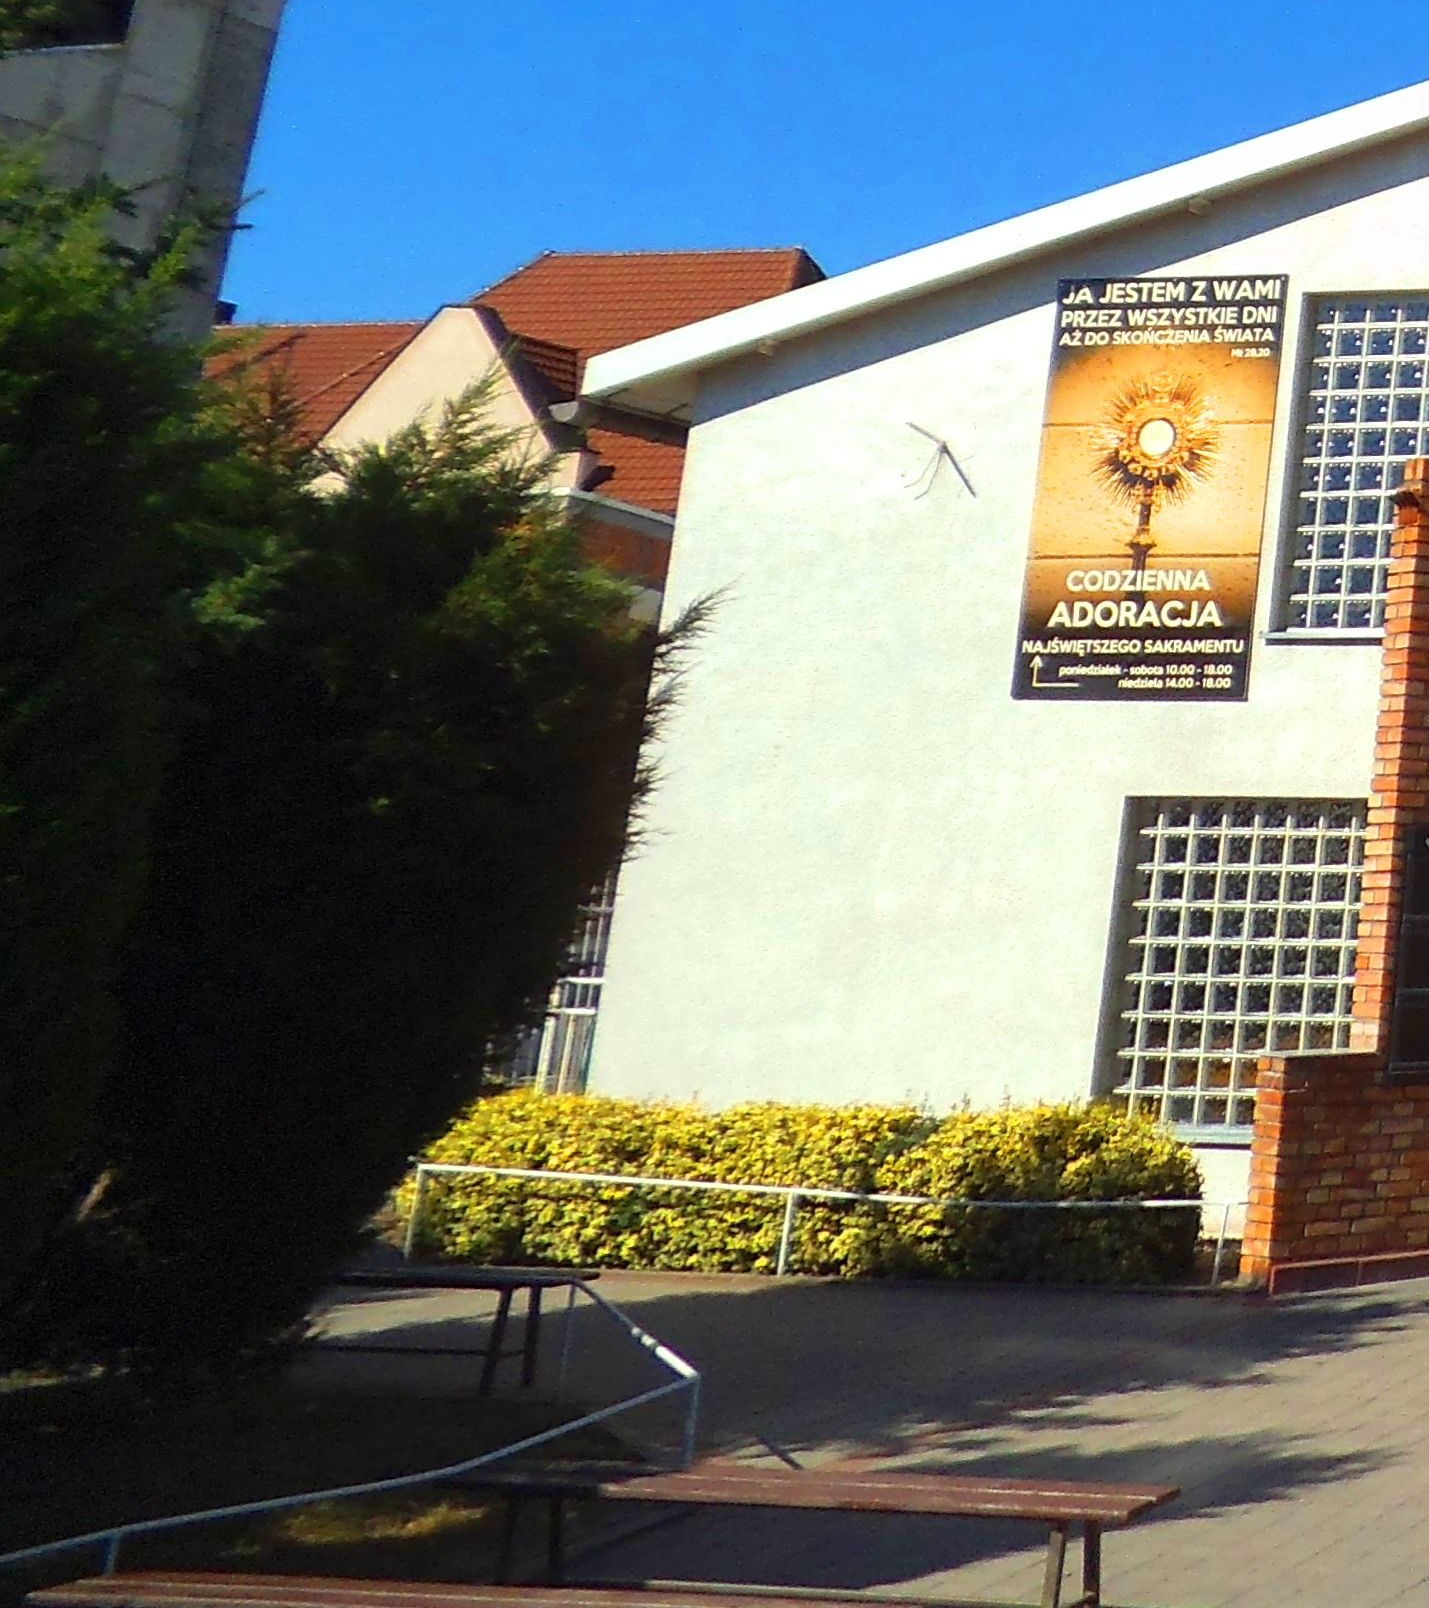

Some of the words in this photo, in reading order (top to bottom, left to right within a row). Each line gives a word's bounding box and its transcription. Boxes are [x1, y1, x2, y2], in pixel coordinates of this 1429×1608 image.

[1062, 285, 1094, 304] JA
[1099, 281, 1185, 304] JESTEM
[1191, 281, 1207, 302] Z
[1213, 279, 1281, 301] WAMI
[1061, 309, 1122, 327] PRZEZ
[1127, 307, 1237, 326] WSZYSTKIE
[1242, 306, 1277, 324] DNI
[1059, 330, 1082, 346] AŻ
[1084, 331, 1109, 345] DO
[1112, 328, 1210, 345] SKOŃCZENIA
[1214, 326, 1274, 343] ŚWIATA
[1066, 569, 1211, 592] CODZIENNA
[1047, 600, 1223, 628] ADORACJA
[1022, 637, 1141, 657] NAJŚWIĘTSZEGO
[1144, 639, 1244, 654] SAKRAMENTU
[1130, 664, 1163, 675] sobota
[1166, 664, 1195, 675] 10.00
[1204, 664, 1233, 675] 18.00
[1118, 677, 1163, 688] niedziela
[1165, 677, 1194, 688] 14.00
